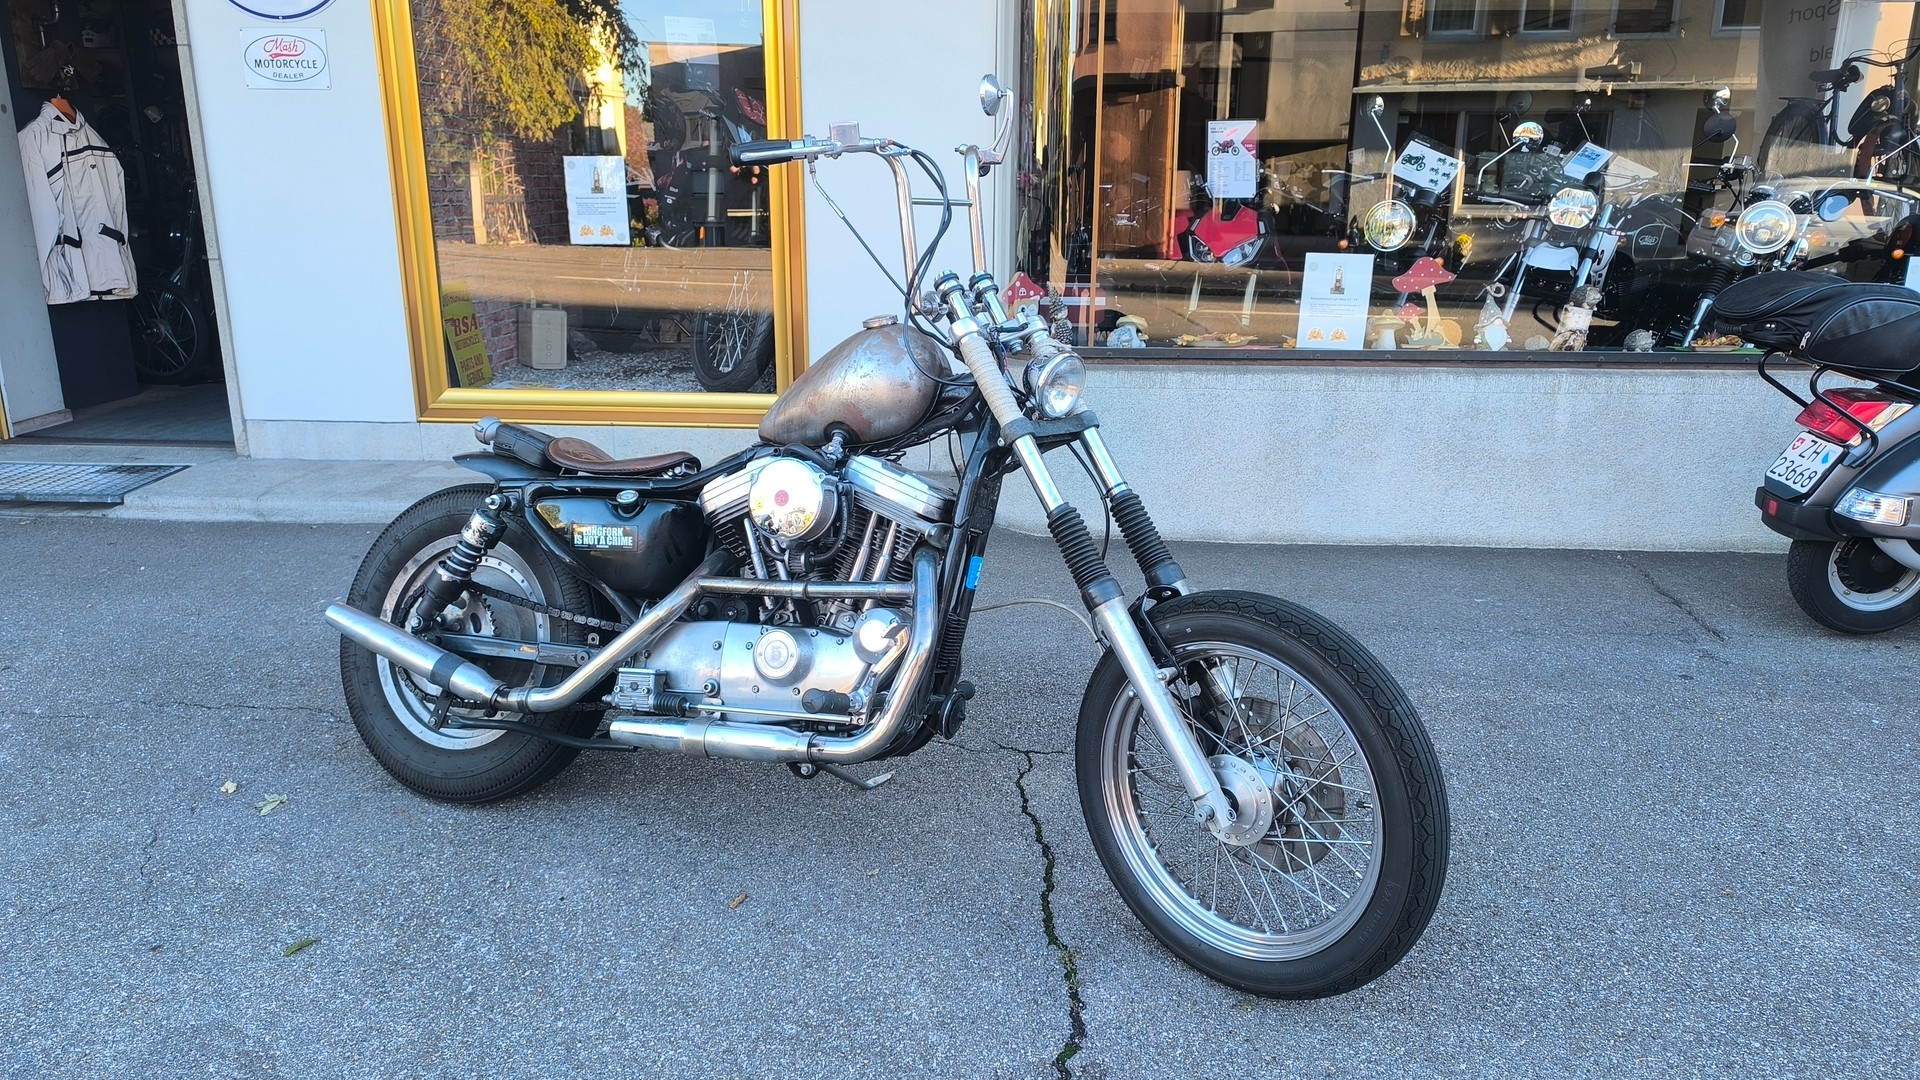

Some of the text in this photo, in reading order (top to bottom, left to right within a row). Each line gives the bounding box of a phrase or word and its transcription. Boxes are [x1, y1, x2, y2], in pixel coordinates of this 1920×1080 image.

[264, 37, 305, 56] Mash
[254, 59, 318, 69] MOTORCYCLE
[272, 71, 304, 79] DEALER
[452, 313, 478, 337] BSA
[545, 319, 553, 359] VALOR
[1798, 439, 1827, 462] ZH
[1769, 456, 1818, 488] 23668
[574, 535, 633, 546] IS NOT A CRIME
[582, 526, 624, 537] LONGFORK
